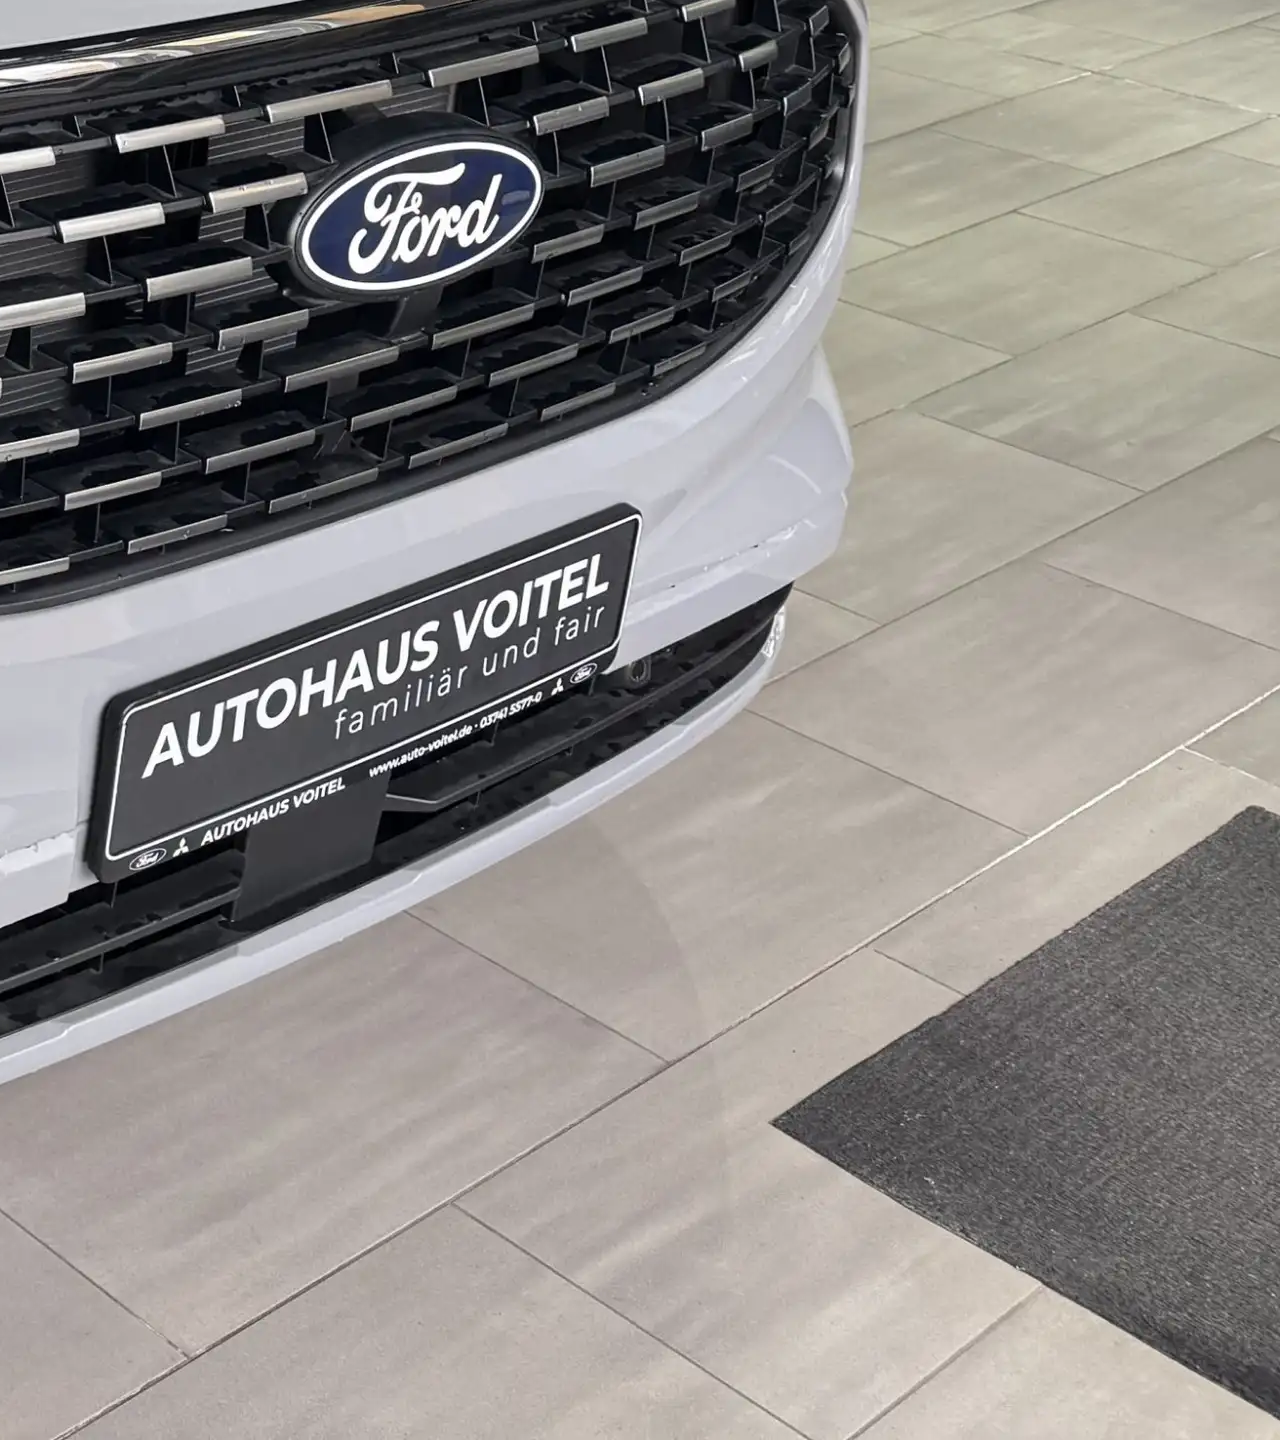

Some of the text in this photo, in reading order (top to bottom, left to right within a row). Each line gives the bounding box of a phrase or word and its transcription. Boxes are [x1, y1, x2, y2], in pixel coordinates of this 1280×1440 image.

[348, 162, 503, 275] Ford
[142, 553, 610, 779] AUTOHAUS VOITEL
[334, 603, 606, 740] familiär und fair
[368, 724, 472, 778] www.auto-voitel.de
[200, 777, 346, 846] AUTOHAUS VOITEL
